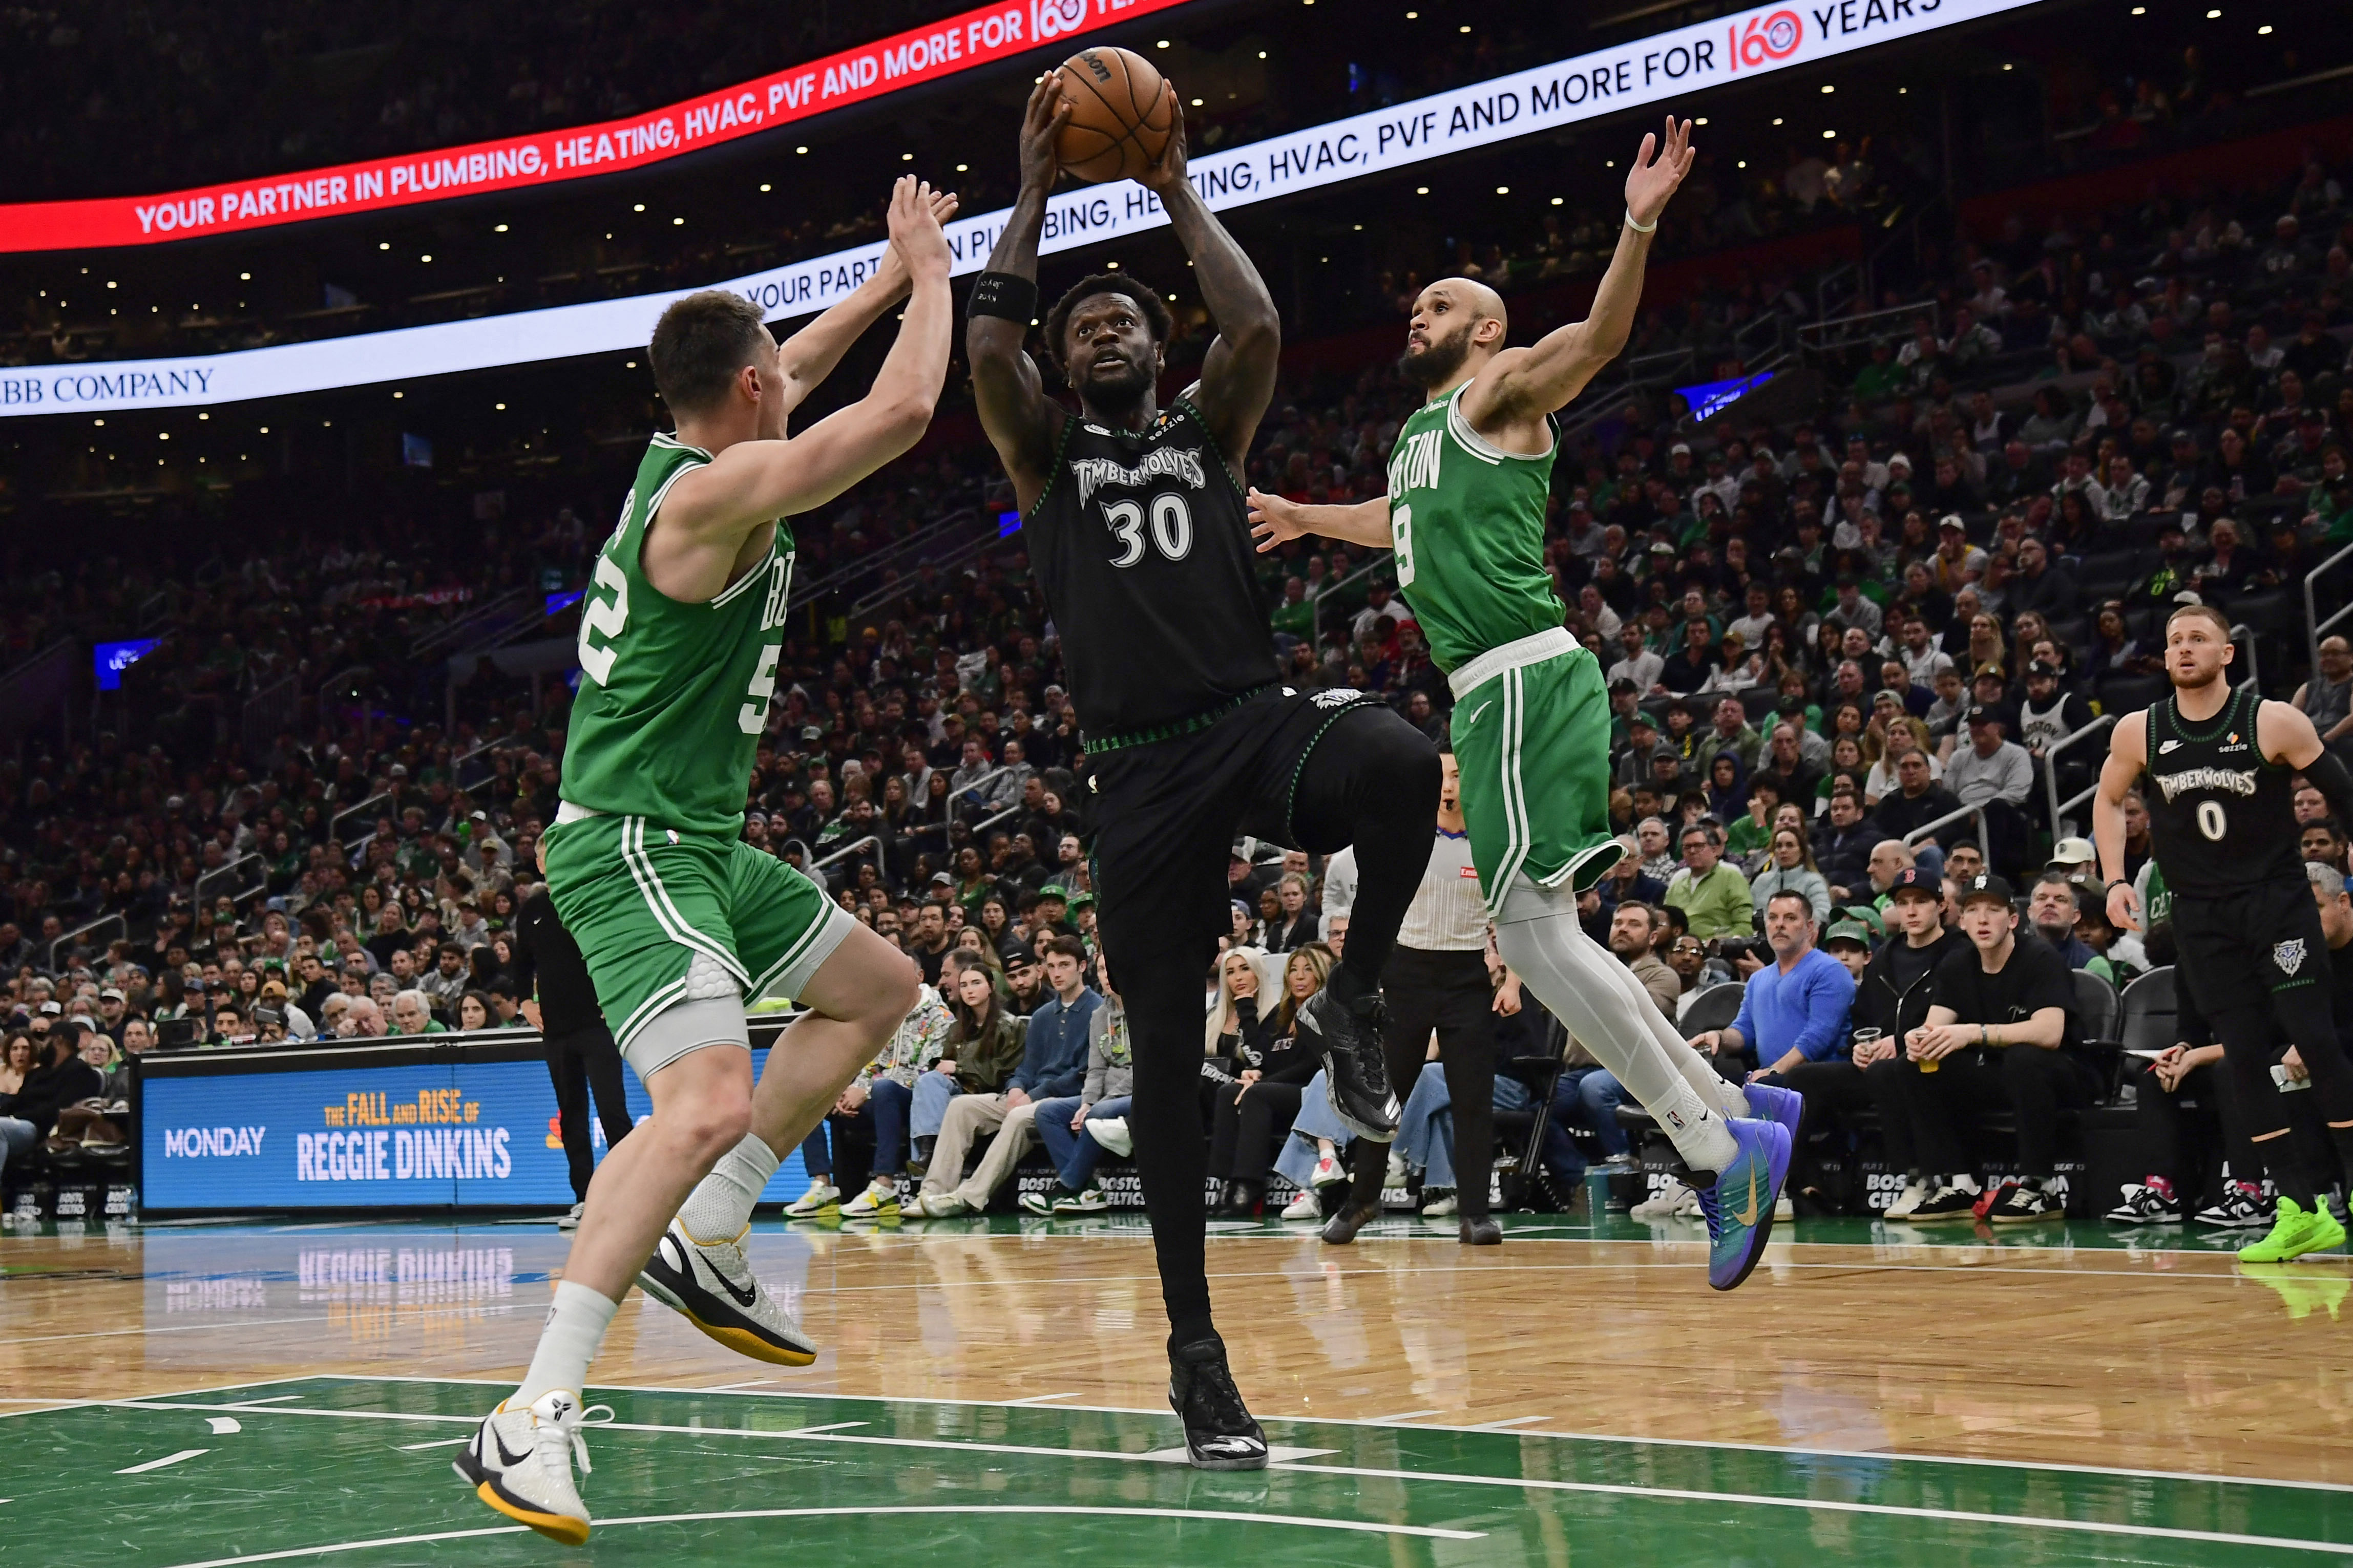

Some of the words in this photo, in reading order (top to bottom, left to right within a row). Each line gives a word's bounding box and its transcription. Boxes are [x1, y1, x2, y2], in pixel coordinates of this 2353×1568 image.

[135, 197, 215, 234] YOUR
[221, 176, 347, 222] PARTNER
[354, 170, 384, 202] IN
[390, 145, 549, 196] PLUMBING,
[555, 118, 681, 169] HEATING,
[685, 93, 764, 140] HVAC,
[768, 73, 816, 115] PVF
[822, 55, 878, 99] AND
[884, 28, 962, 80] MORE
[968, 9, 1023, 54] FOR
[1030, 0, 1088, 43] 160
[747, 276, 811, 309] YOUR
[820, 257, 880, 295] PART
[948, 236, 962, 261] N
[972, 199, 1118, 257] PLBING,
[1126, 162, 1260, 219] HEING,
[1270, 134, 1368, 182] HVAC,
[1378, 112, 1437, 155] PVF
[1448, 93, 1520, 137] AND
[1531, 60, 1632, 115] MORE
[1645, 40, 1714, 86] FOR
[1729, 10, 1803, 72] 160
[0, 379, 43, 405] BB
[54, 368, 214, 402] COMPANY
[1148, 414, 1185, 441] sezzle
[1386, 429, 1444, 505] STON
[1099, 492, 1194, 568] 30
[1392, 503, 1416, 588] 9
[578, 553, 629, 687] 2
[738, 644, 783, 735] 5
[2218, 743, 2249, 753] sezzle
[2196, 799, 2227, 842] 0
[1904, 868, 1916, 884] B
[324, 1106, 345, 1127] THE
[347, 1092, 391, 1126] FALL
[392, 1104, 417, 1124] AND
[418, 1089, 463, 1124] RISE
[464, 1101, 480, 1123] OF
[165, 1127, 266, 1158] MONDAY
[297, 1131, 390, 1181] REGGIE
[395, 1127, 511, 1179] DINKINS
[1017, 1177, 1056, 1191] BOST
[1098, 1177, 1142, 1191] BOSTO
[1266, 1191, 1301, 1205] CELT
[1866, 1174, 1907, 1191] BOS
